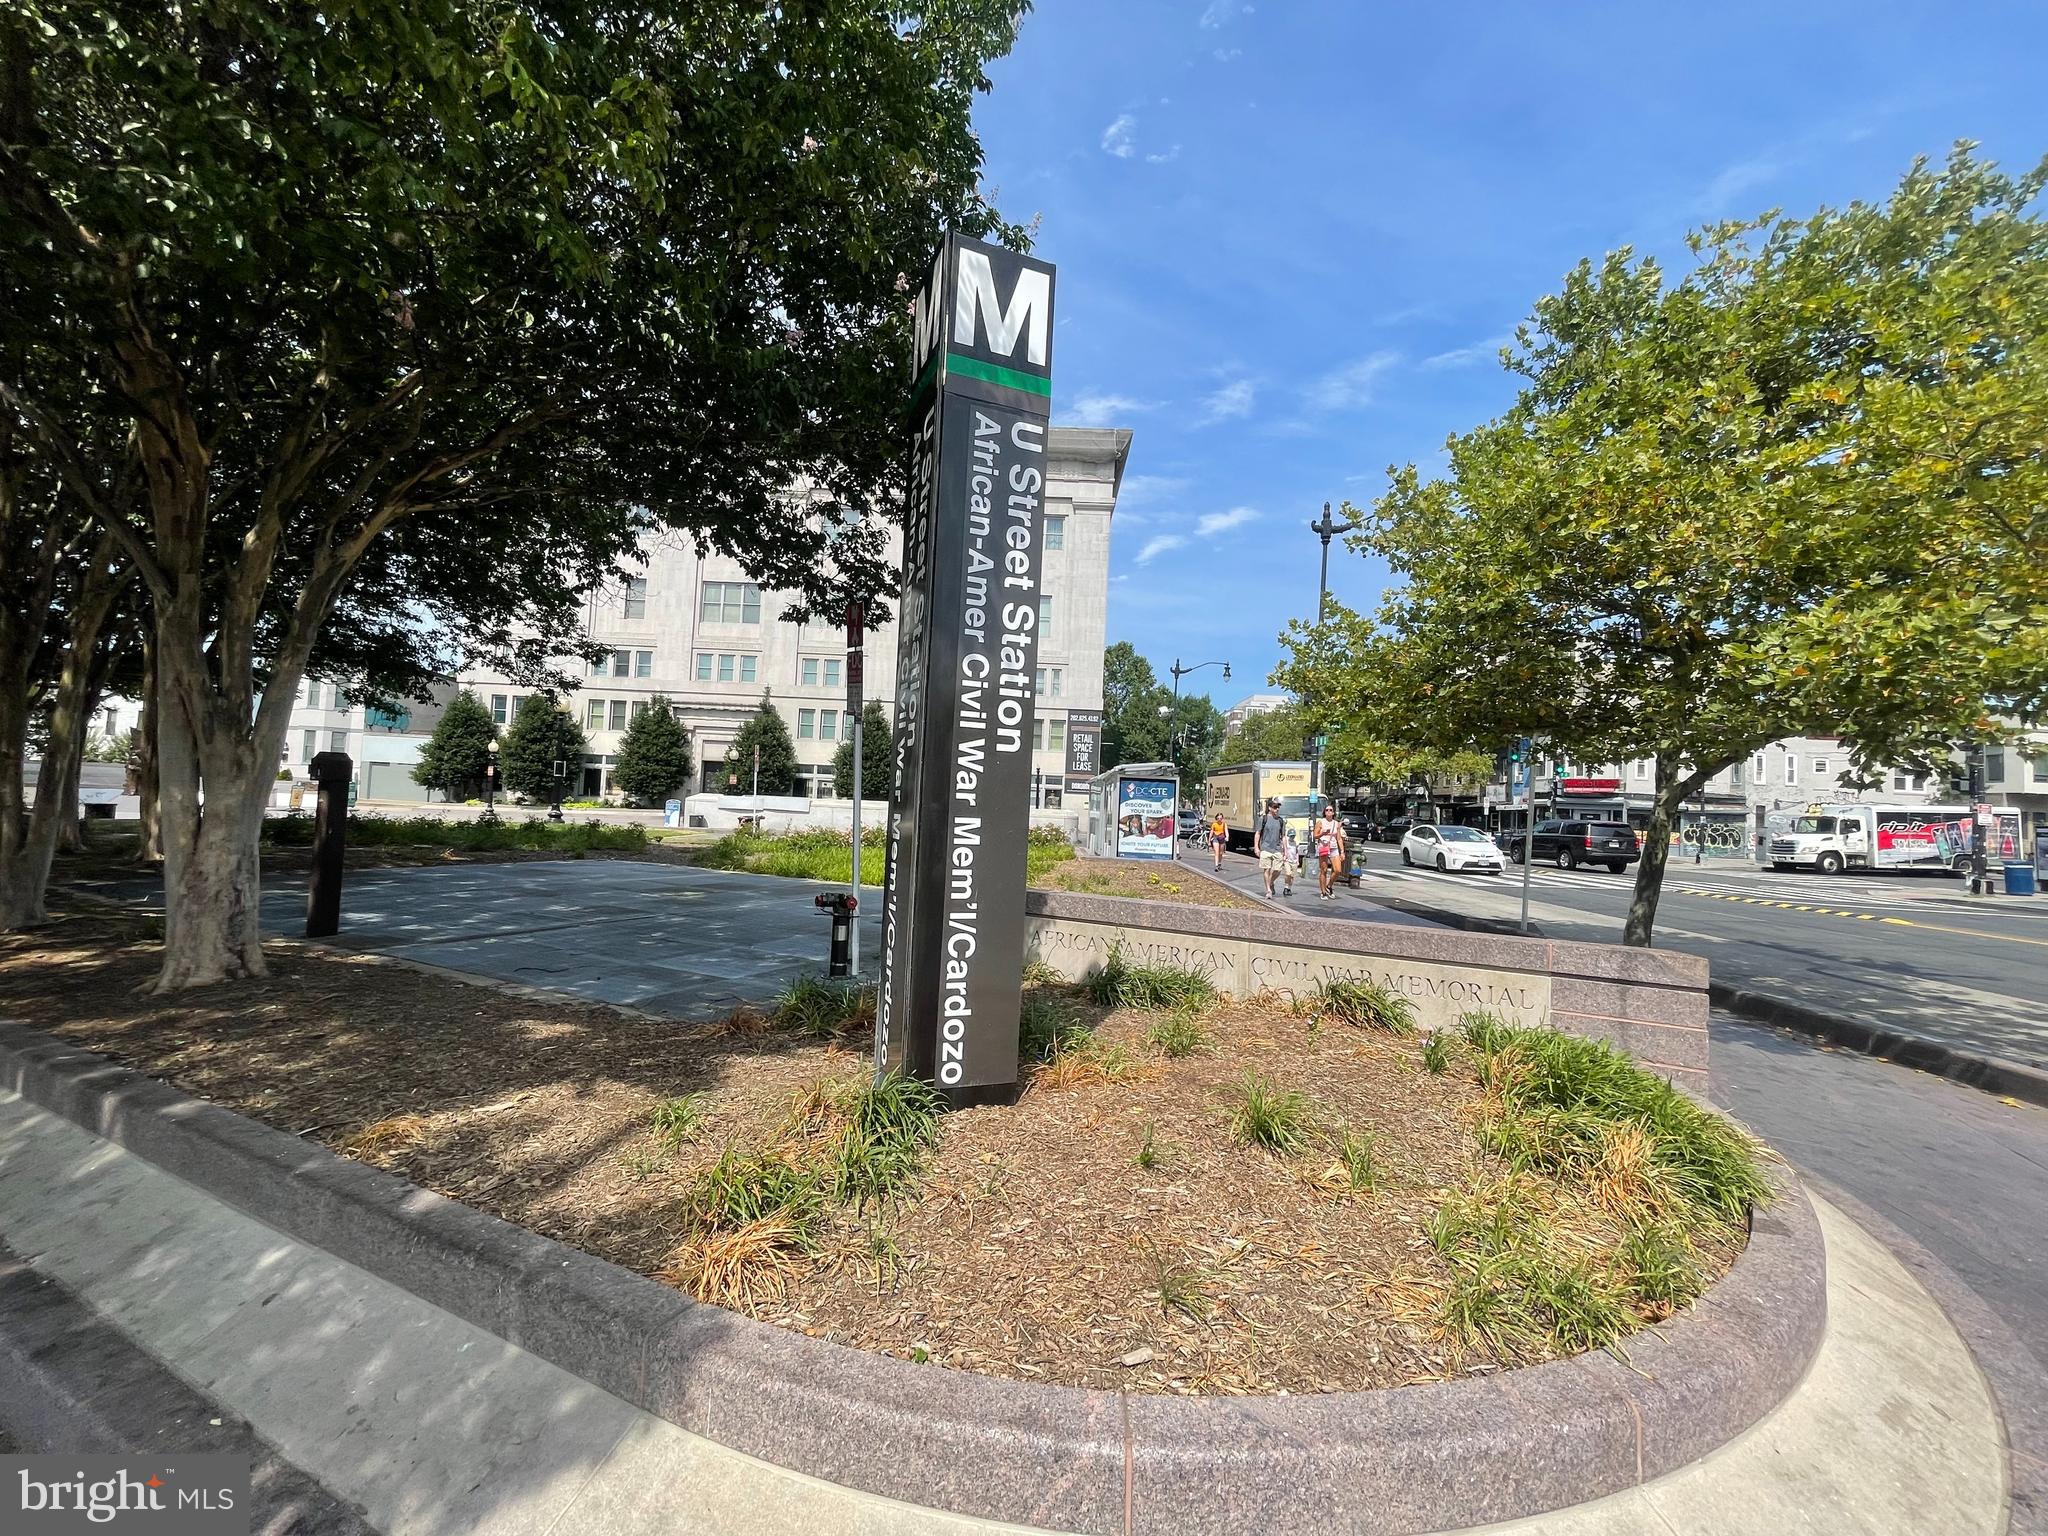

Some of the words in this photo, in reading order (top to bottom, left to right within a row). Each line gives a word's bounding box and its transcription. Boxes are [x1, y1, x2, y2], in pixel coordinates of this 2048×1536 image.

[912, 247, 943, 385] M
[954, 247, 1051, 366] M
[924, 405, 935, 441] U
[1010, 421, 1043, 452] U
[903, 432, 922, 646] African-Amer
[915, 452, 932, 584] Street
[962, 410, 1001, 643] African-Amer
[1004, 463, 1042, 592] Street
[898, 656, 910, 729] Civil
[907, 593, 925, 747] Station
[956, 653, 990, 728] Civil
[995, 602, 1036, 752] Station
[895, 736, 906, 803] War
[952, 736, 985, 806] War
[1072, 761, 1092, 771] LEASE
[1073, 733, 1094, 743] RETAIL
[1073, 743, 1093, 753] SPACE
[1076, 753, 1089, 762] FOR
[1878, 821, 1909, 833] rip
[1909, 821, 1928, 833] it
[881, 813, 902, 1066] Mem'l/Cardozo
[940, 817, 983, 1085] Mem'l/Cardozo
[1121, 942, 1236, 970] AMERICAN
[1251, 956, 1317, 982] CIVIL
[1321, 965, 1373, 986] WAR
[1383, 973, 1536, 1010] MEMORIAL
